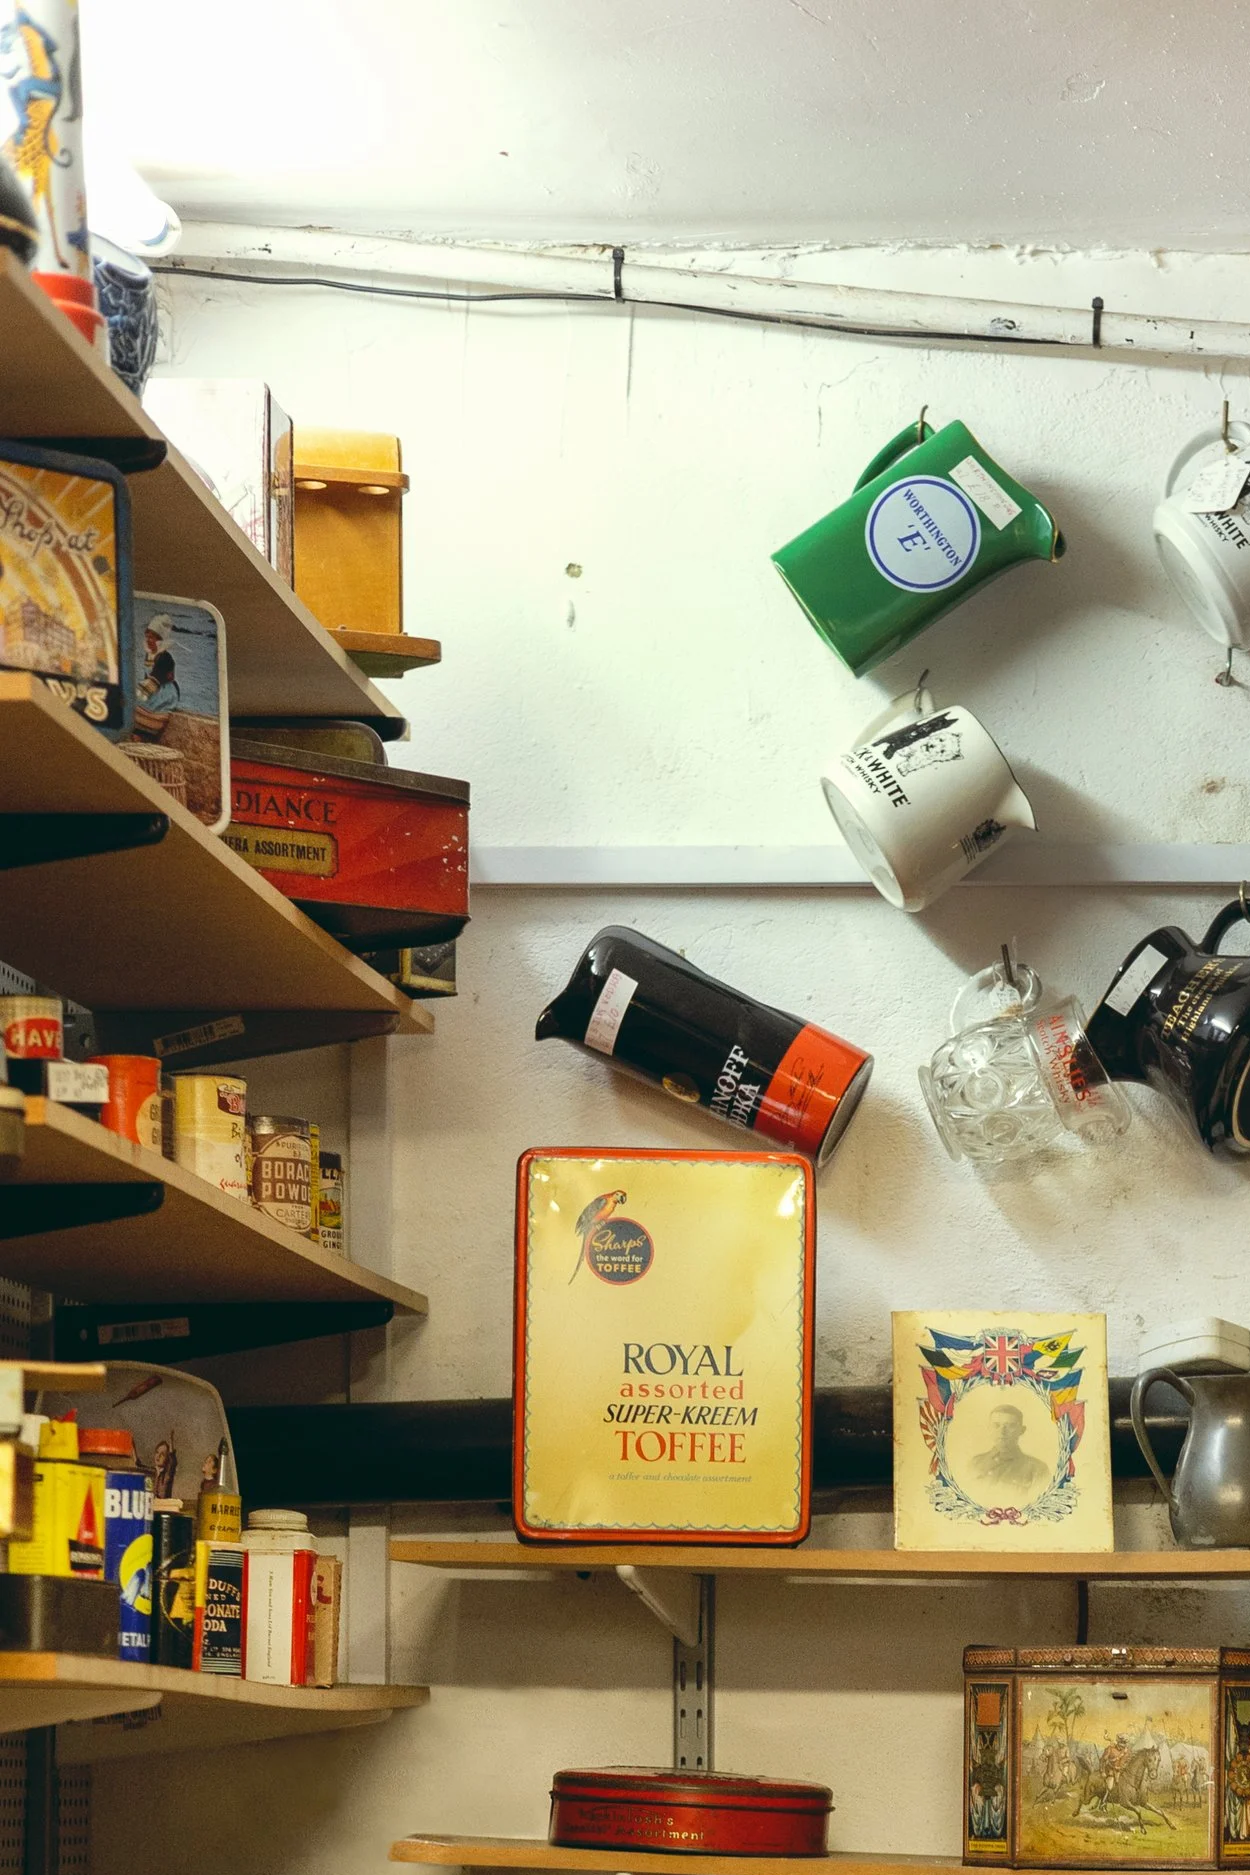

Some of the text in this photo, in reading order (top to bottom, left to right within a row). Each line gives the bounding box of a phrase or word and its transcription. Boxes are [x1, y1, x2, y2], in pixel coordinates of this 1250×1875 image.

[67, 525, 96, 552] at
[902, 488, 963, 567] WORTHINGTON
[1204, 514, 1229, 542] WHISKY
[855, 765, 881, 795] WHISKY
[254, 840, 328, 863] ASSORTMENT
[1162, 957, 1227, 1039] TEACHER'S
[1177, 1005, 1194, 1028] The
[1180, 994, 1214, 1043] Highland
[1049, 1058, 1071, 1104] Whisky
[595, 1254, 644, 1263] the word for
[597, 1263, 642, 1274] TOFFEE
[623, 1342, 745, 1377] ROYAL
[619, 1379, 744, 1400] assorted
[602, 1403, 759, 1426] SUPER-KREEM
[614, 1430, 747, 1463] TOFFEE
[616, 1472, 641, 1482] toffee
[642, 1472, 661, 1482] and
[663, 1472, 701, 1483] chocolate
[702, 1474, 752, 1483] assortment
